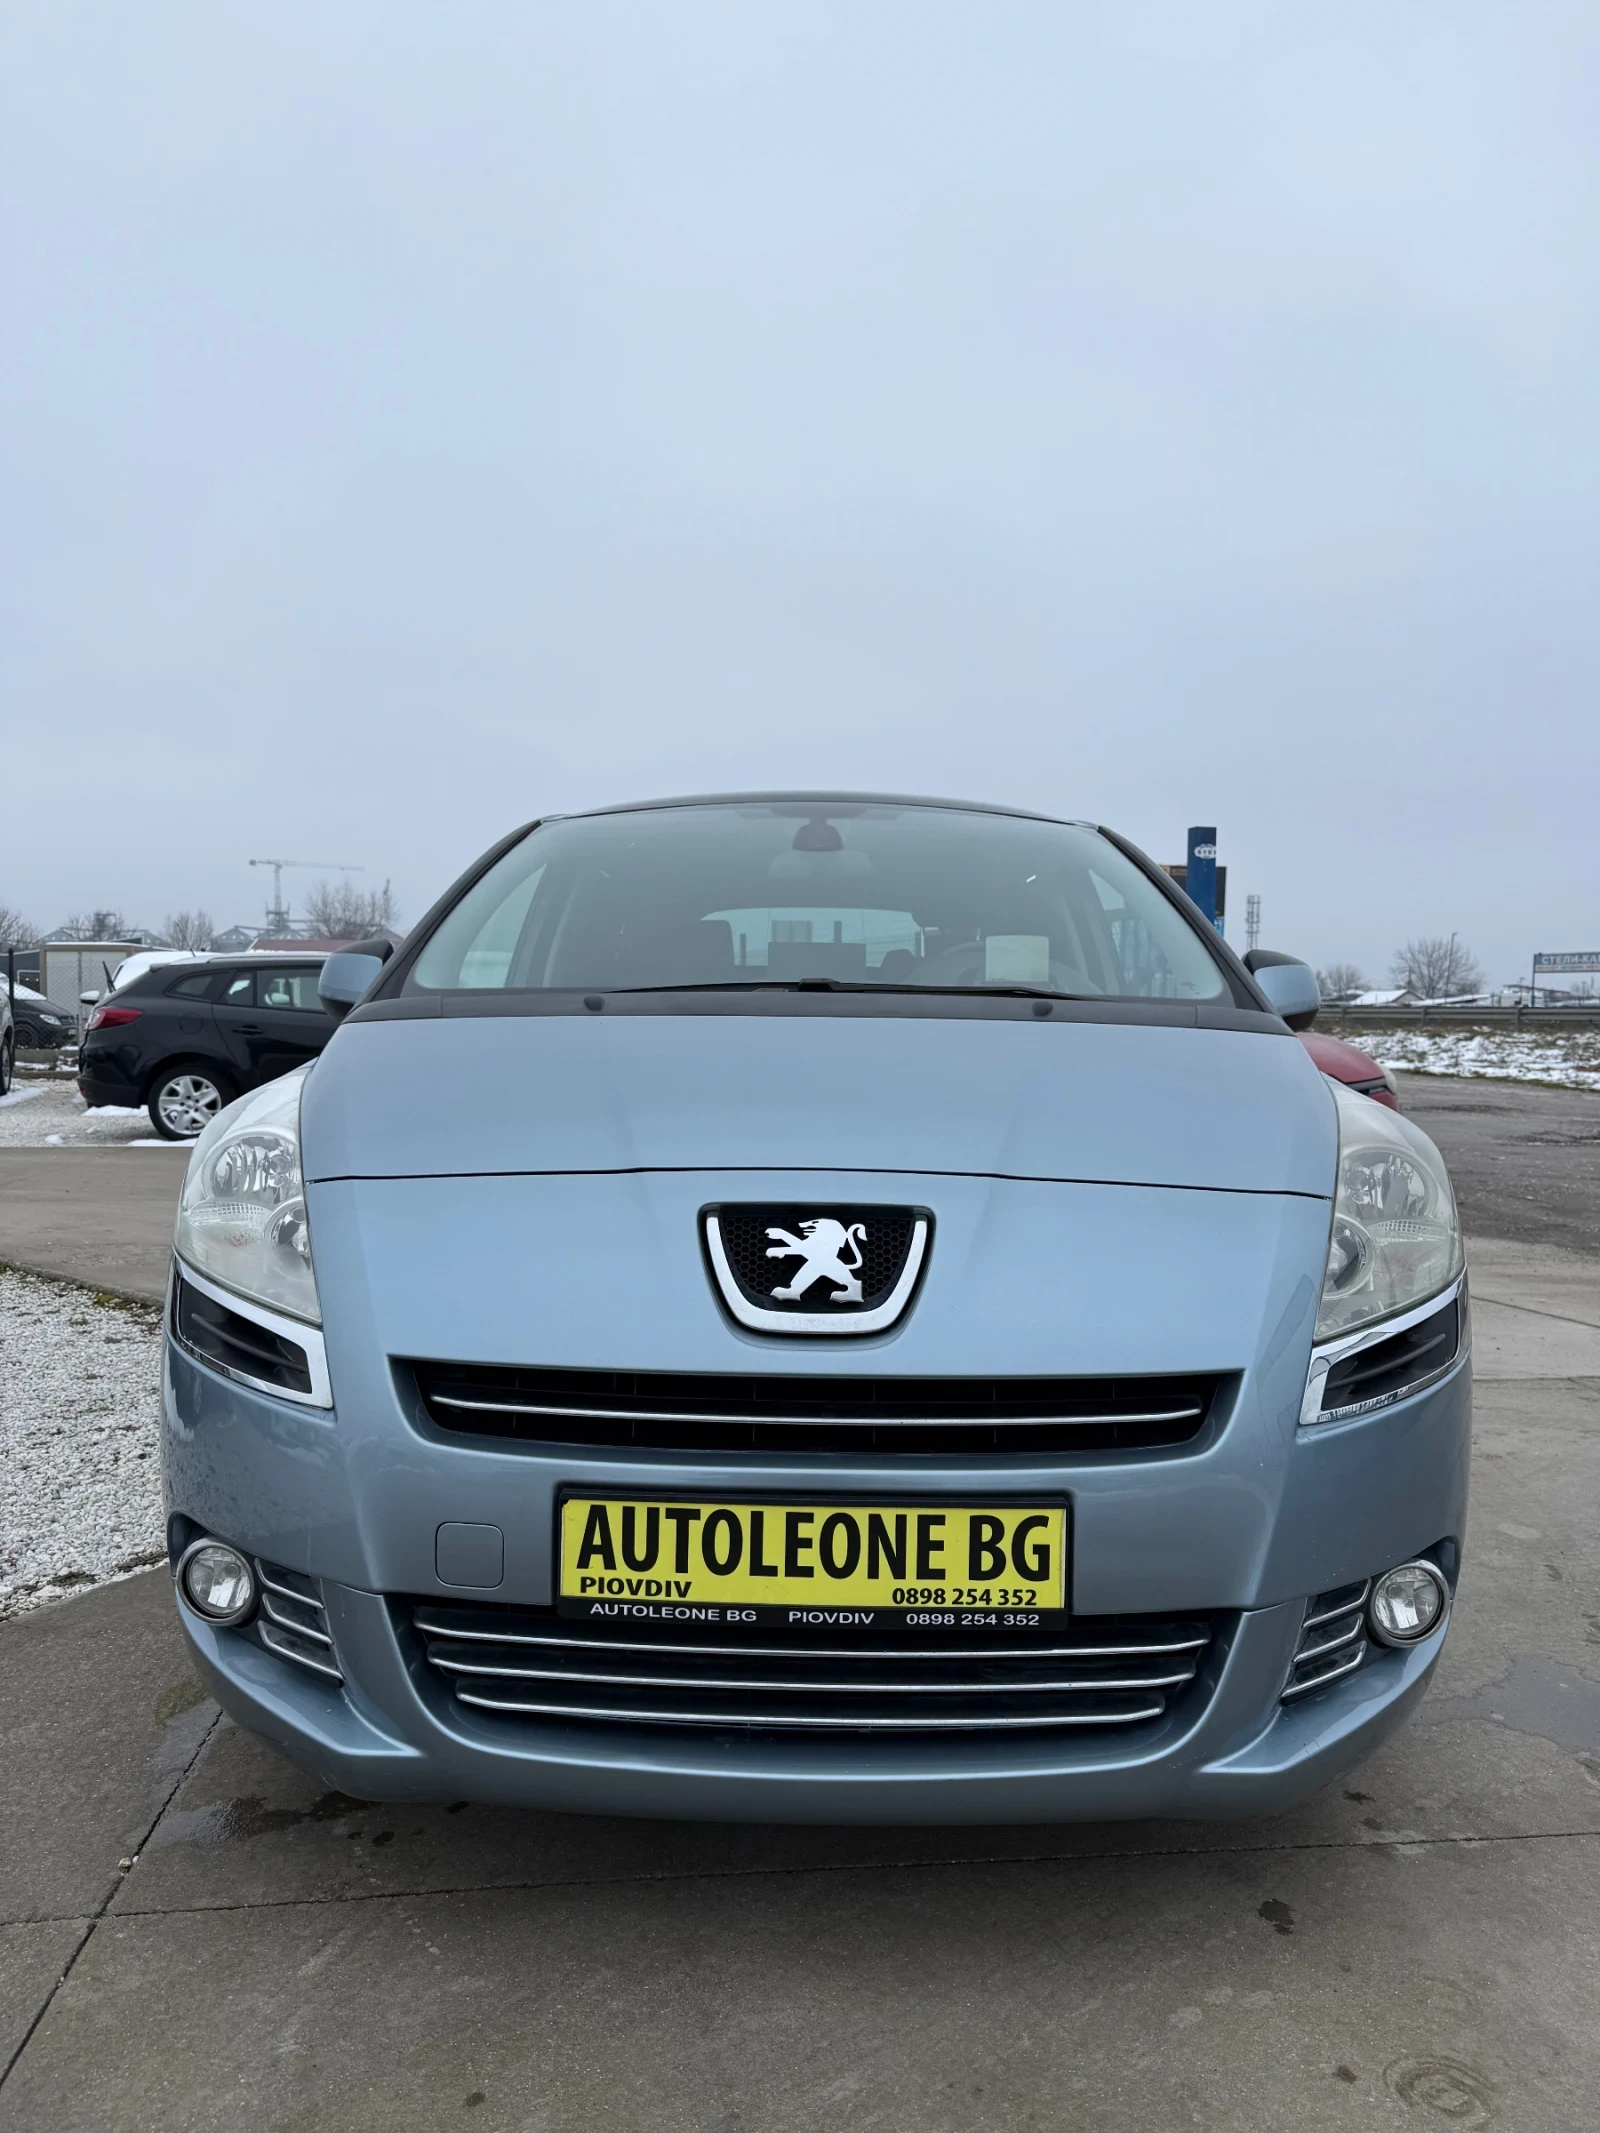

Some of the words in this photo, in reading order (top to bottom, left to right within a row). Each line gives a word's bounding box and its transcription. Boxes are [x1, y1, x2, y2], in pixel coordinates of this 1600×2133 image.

[576, 1504, 946, 1581] AUTOLEONE
[968, 1514, 1051, 1582] BG
[580, 1576, 693, 1599] PIOVDIV
[891, 1587, 947, 1605] 0898
[951, 1587, 993, 1606] 254
[997, 1588, 1037, 1606] 352
[590, 1603, 720, 1621] AUTOLEONE
[726, 1609, 757, 1622] BG
[788, 1611, 875, 1624] PIOVDIV
[906, 1613, 955, 1625] 0898
[961, 1613, 998, 1625] 254
[1003, 1614, 1039, 1626] 352
